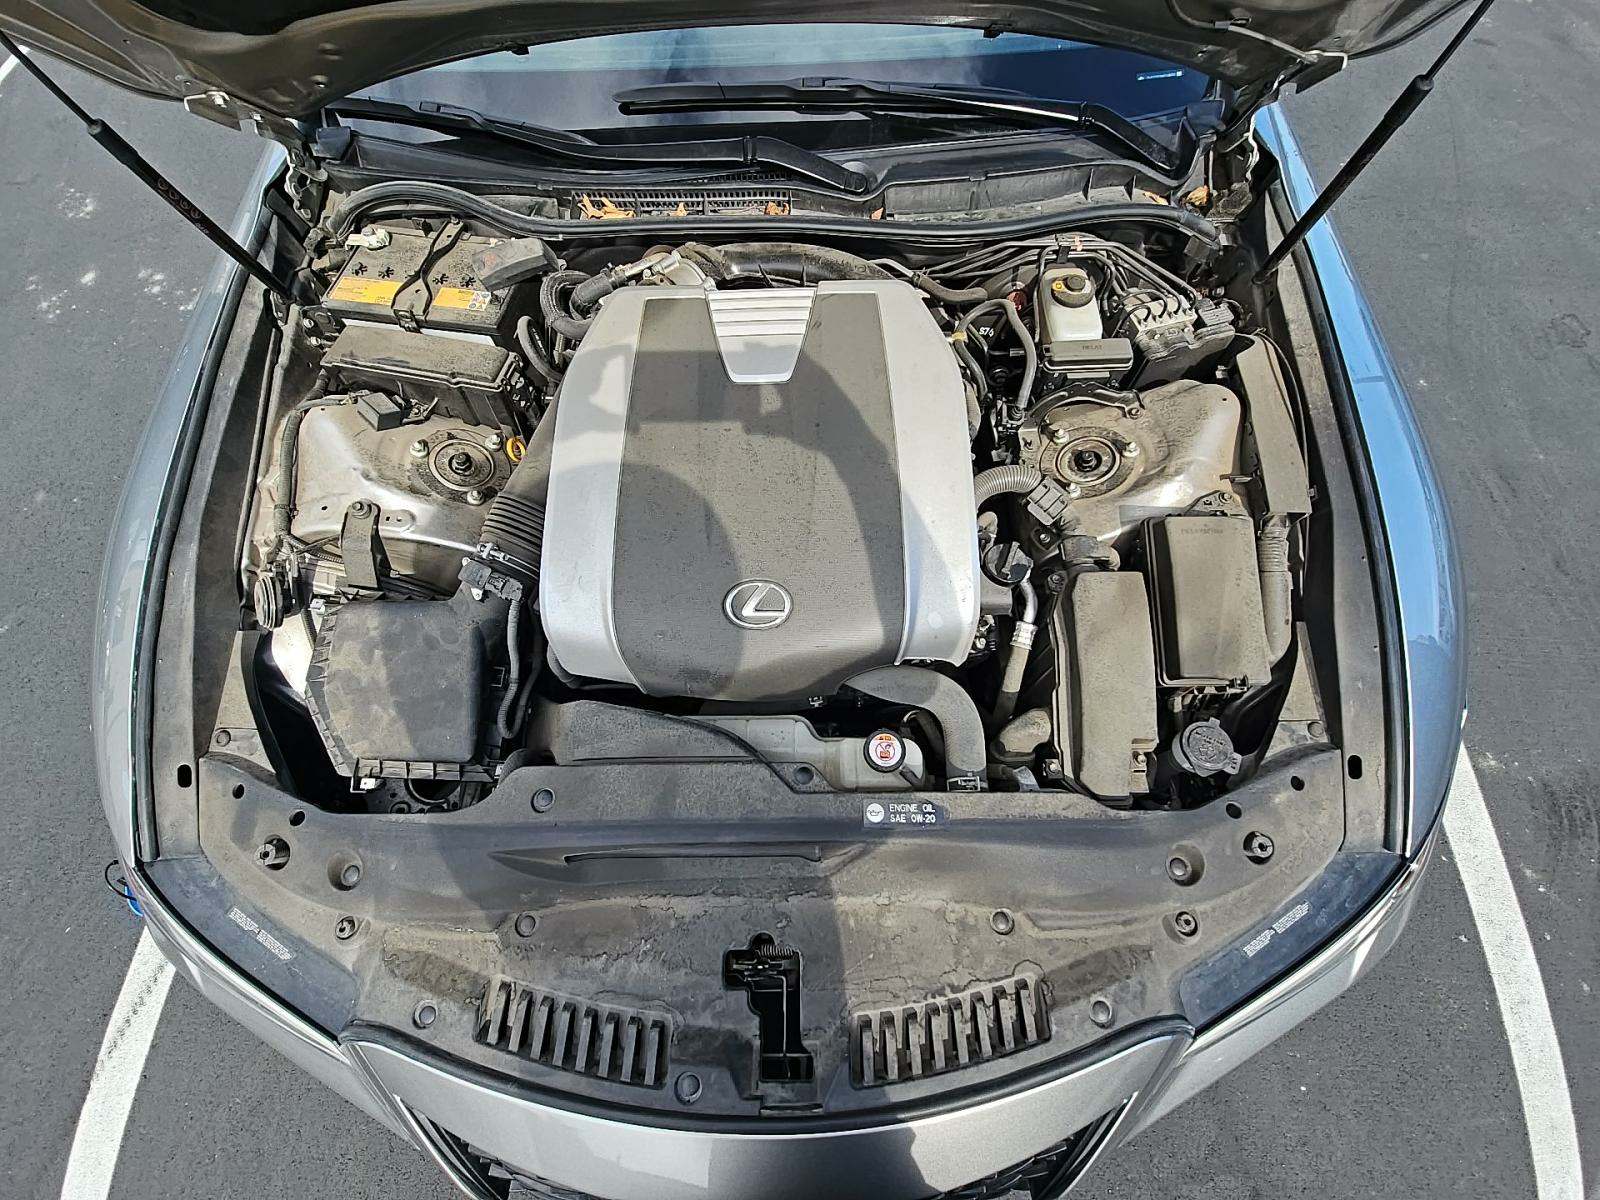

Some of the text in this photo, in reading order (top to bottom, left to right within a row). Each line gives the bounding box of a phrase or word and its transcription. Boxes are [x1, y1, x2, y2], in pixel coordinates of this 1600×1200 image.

[889, 803, 936, 813] ENGINE OIL
[890, 813, 936, 823] SAE 0W-20
